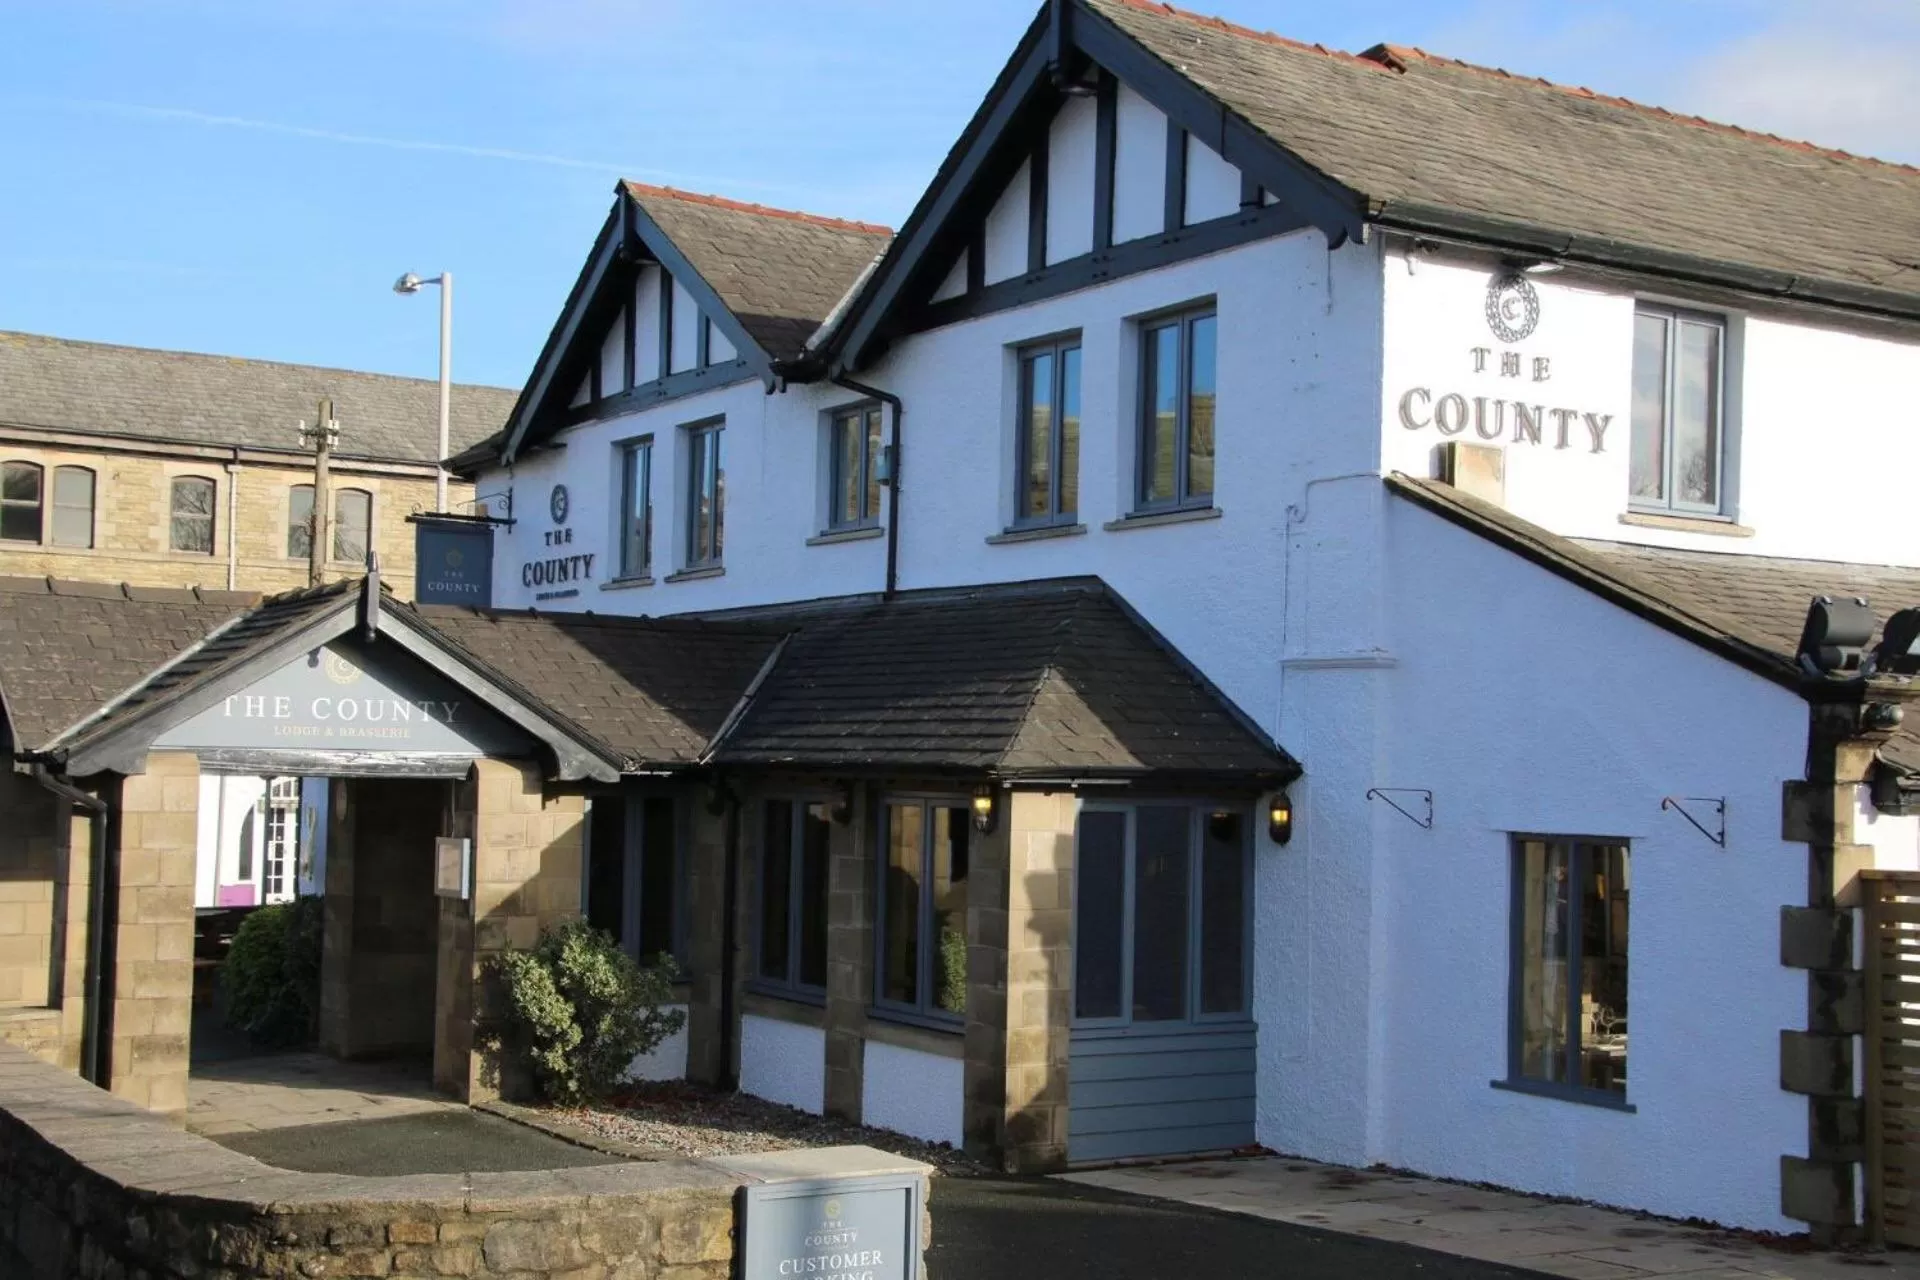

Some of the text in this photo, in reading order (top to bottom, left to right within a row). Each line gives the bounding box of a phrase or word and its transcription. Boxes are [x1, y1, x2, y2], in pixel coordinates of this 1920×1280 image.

[1470, 346, 1551, 382] THE
[1398, 387, 1613, 454] COUNTY
[544, 528, 573, 547] THE
[522, 552, 595, 589] COUNTY
[427, 581, 481, 593] COUNTY
[223, 695, 460, 723] THE COUNTY
[274, 725, 321, 737] LODGE
[339, 727, 411, 738] BRASSERIE
[804, 1231, 857, 1246] COUNTY
[779, 1250, 883, 1275] CUSTOMER
